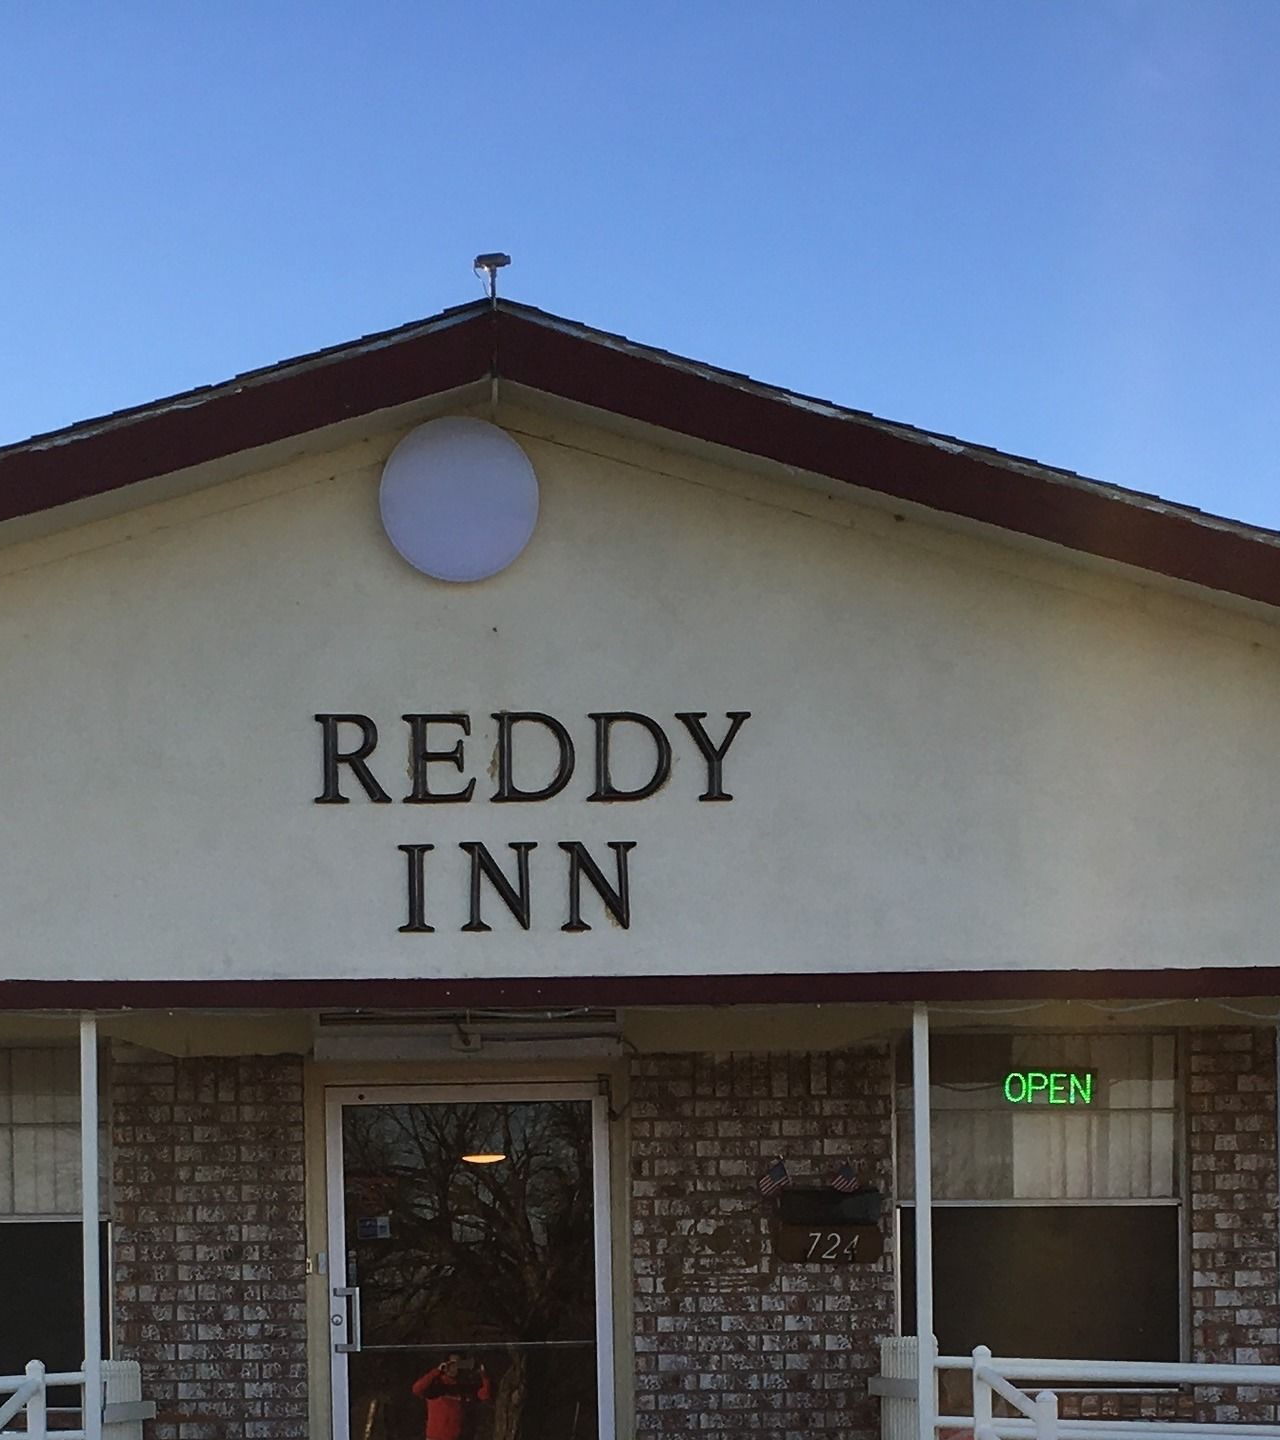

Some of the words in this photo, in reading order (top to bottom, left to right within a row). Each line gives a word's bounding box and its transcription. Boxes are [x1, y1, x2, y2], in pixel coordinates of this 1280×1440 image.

[314, 711, 752, 804] REDDY
[398, 841, 637, 933] INN
[1004, 1072, 1092, 1104] OPEN
[806, 1232, 860, 1261] 724
